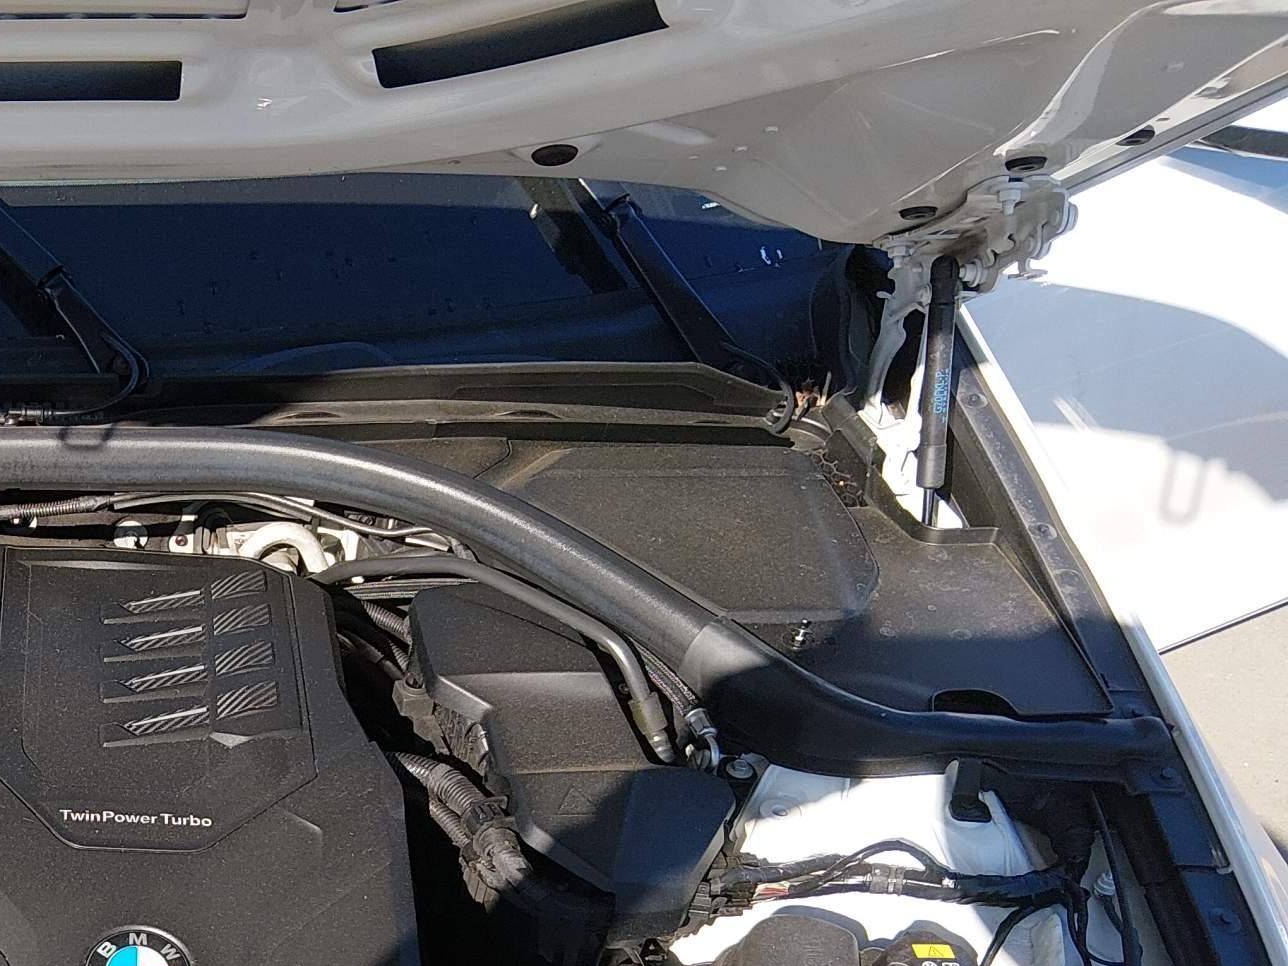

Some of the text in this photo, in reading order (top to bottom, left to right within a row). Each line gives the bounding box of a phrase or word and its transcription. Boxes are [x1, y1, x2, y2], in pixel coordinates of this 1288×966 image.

[59, 808, 213, 827] TwinPower Turbo
[96, 932, 182, 961] BMW
